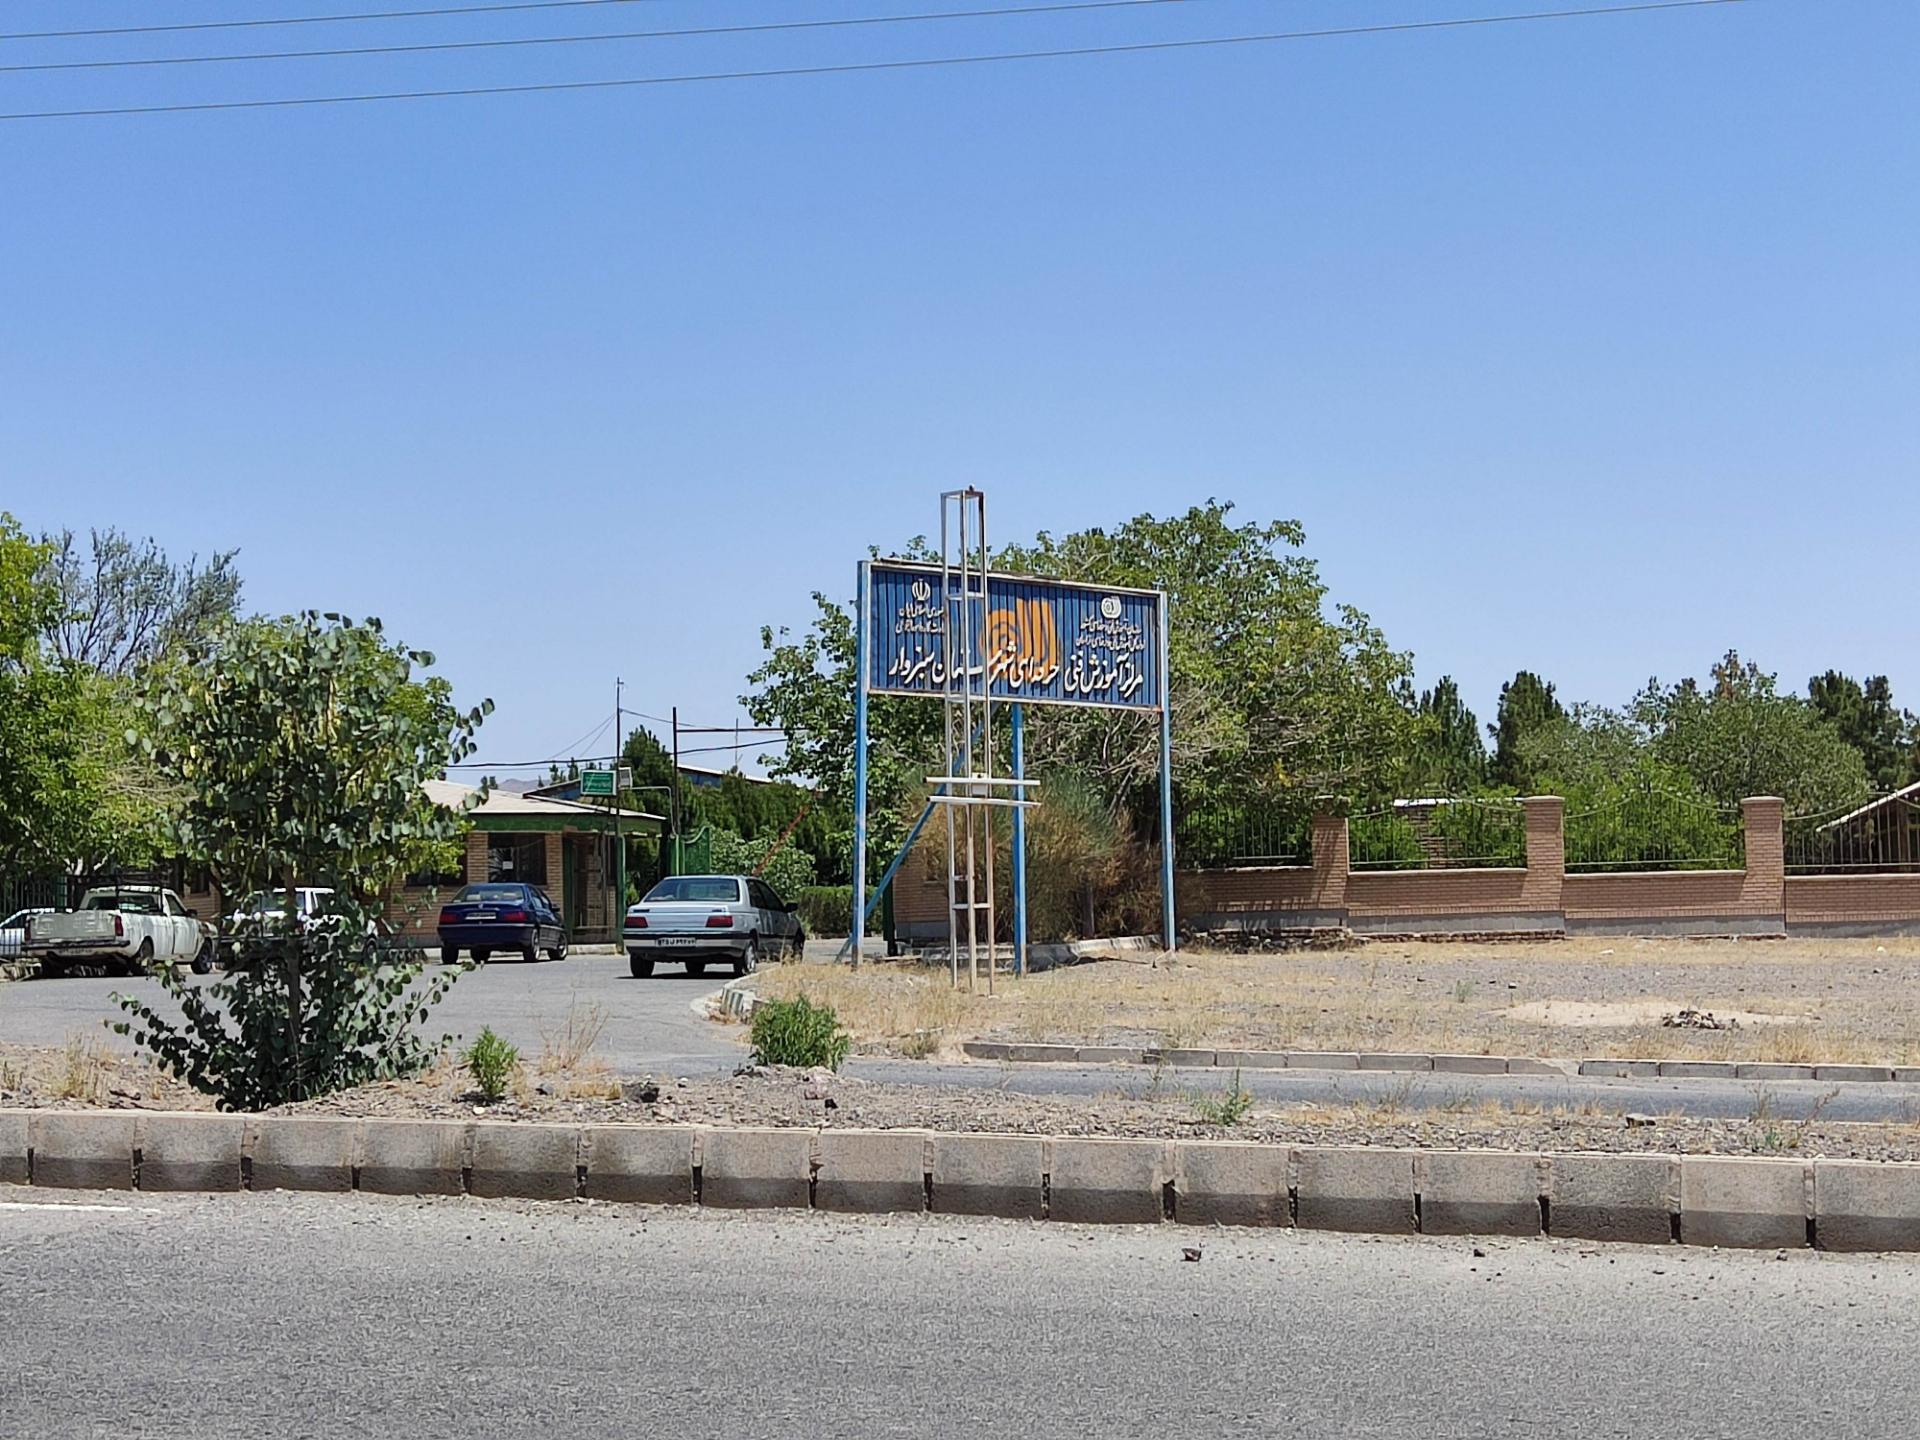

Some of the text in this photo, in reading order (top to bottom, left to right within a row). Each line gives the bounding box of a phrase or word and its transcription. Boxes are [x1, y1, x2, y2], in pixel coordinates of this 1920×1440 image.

[889, 646, 934, 685] سبزوار
[931, 640, 1017, 686] شهرستان
[1064, 650, 1084, 692] فنی
[1080, 651, 1128, 693] آموزش
[1119, 661, 1144, 698] مرکز
